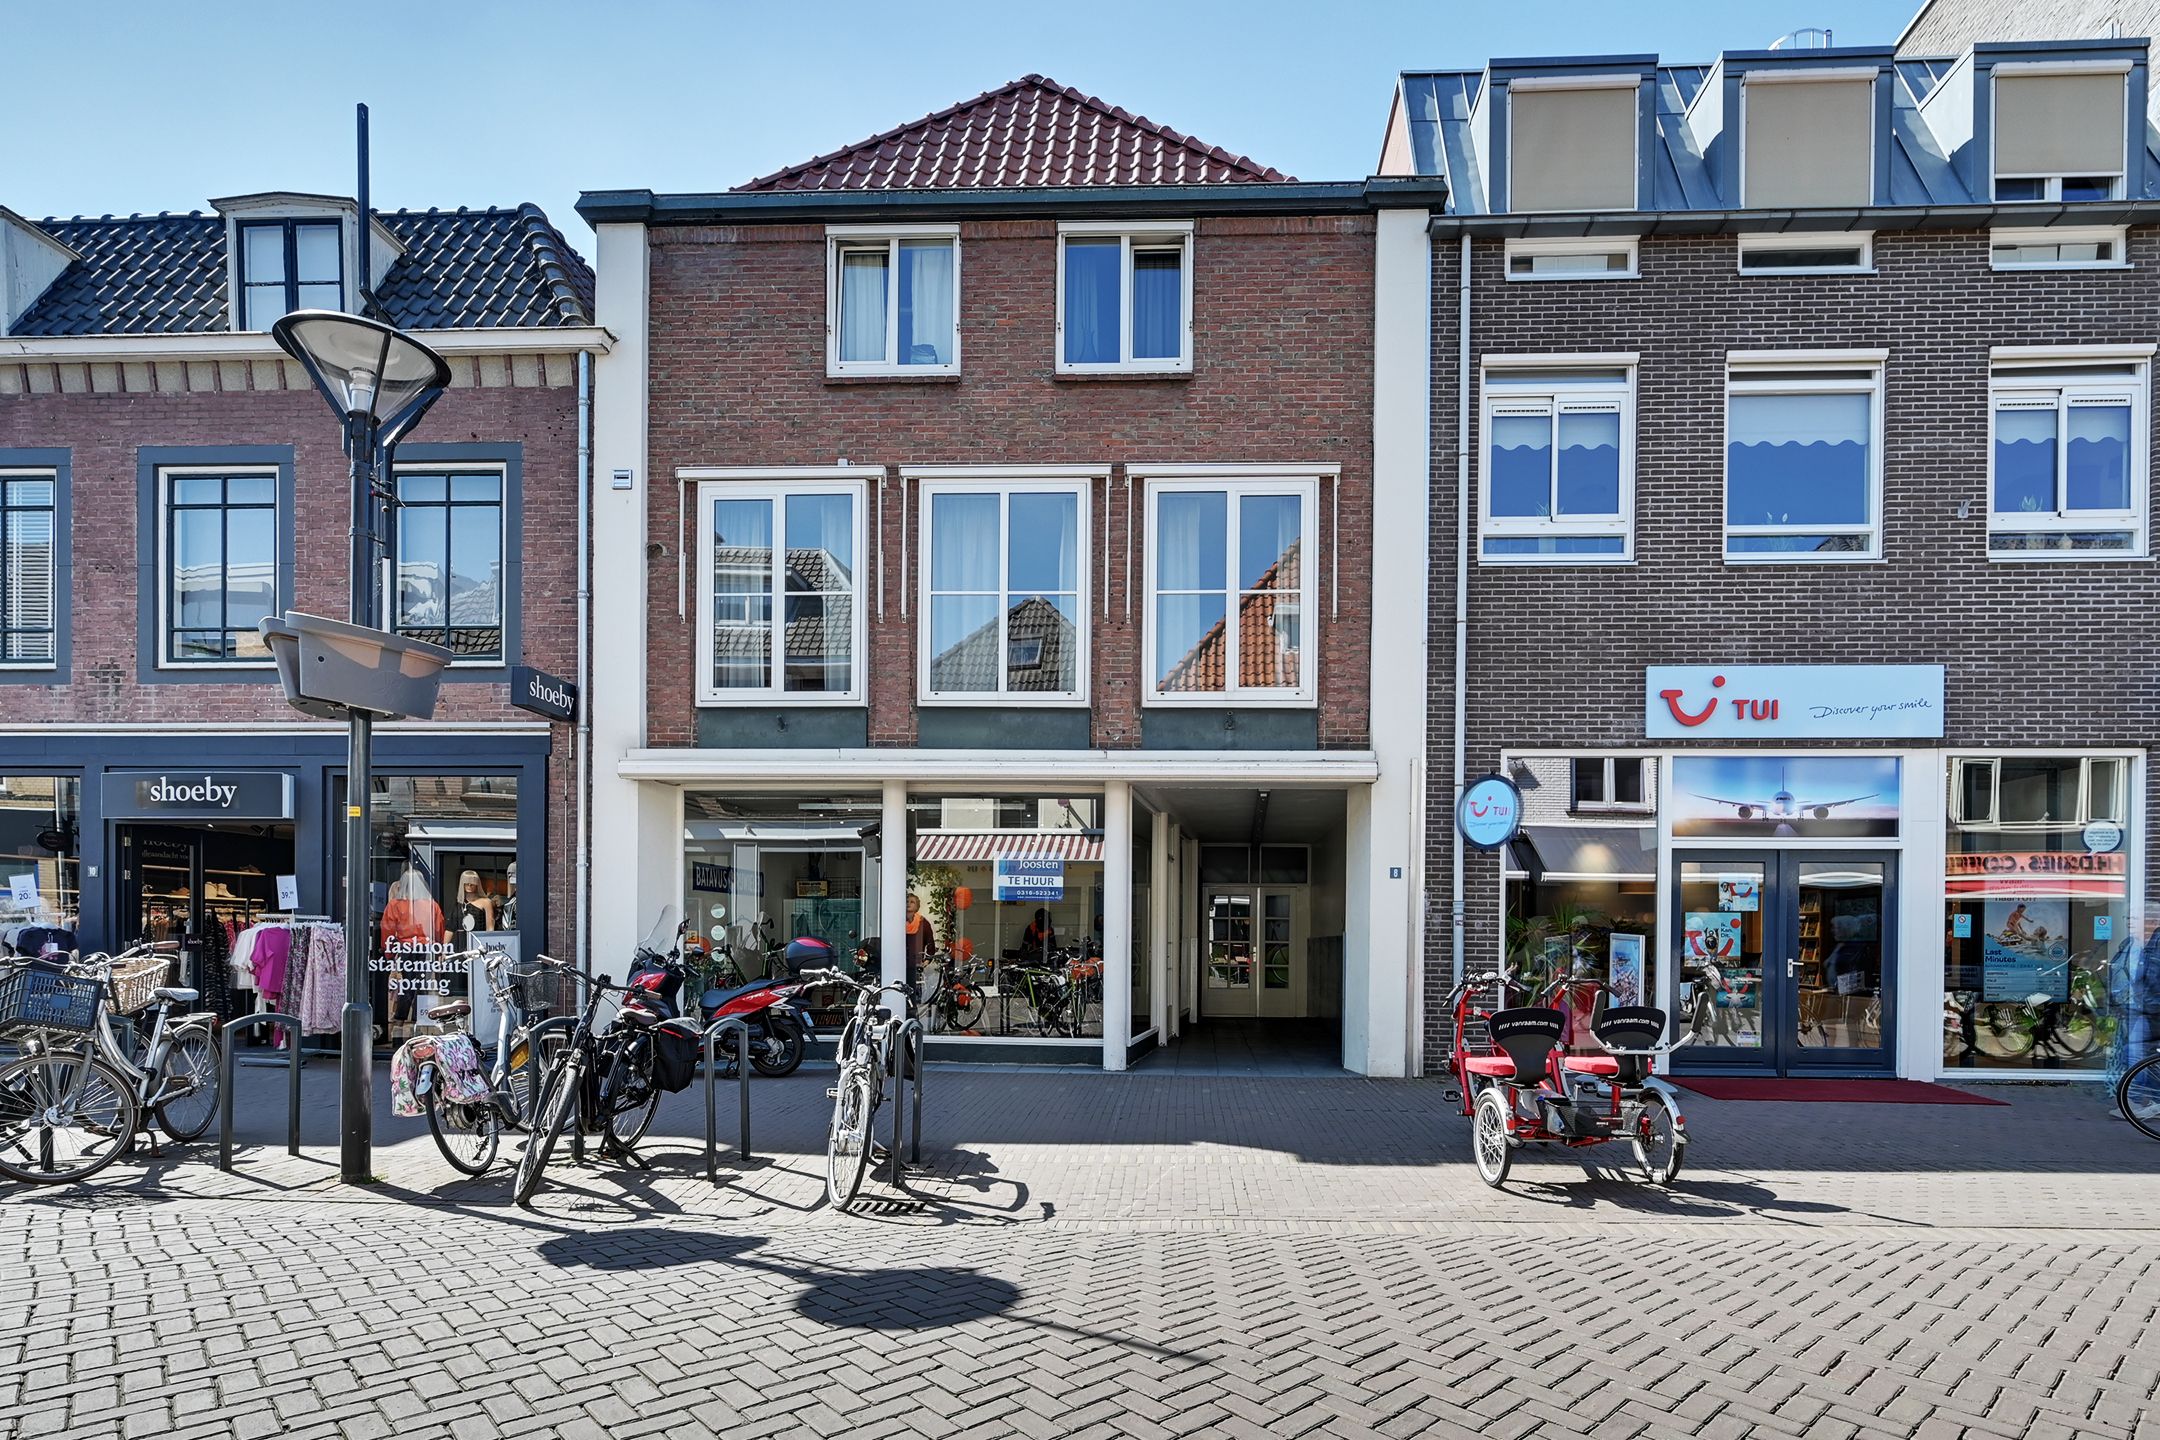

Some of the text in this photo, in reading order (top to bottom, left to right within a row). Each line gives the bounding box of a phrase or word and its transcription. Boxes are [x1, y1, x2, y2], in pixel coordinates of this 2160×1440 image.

[529, 675, 574, 715] shoeby
[1732, 699, 1779, 720] TUI
[1809, 697, 1933, 721] Discover your smile
[150, 775, 238, 808] shoeby
[1493, 806, 1509, 816] TUI
[89, 867, 96, 876] 10
[1019, 860, 1058, 870] Joosten
[1393, 868, 1399, 878] 8
[696, 866, 728, 889] BATAVUS
[1008, 876, 1055, 886] TE HUUR
[384, 935, 455, 954] fashion
[368, 957, 470, 974] statements
[388, 973, 451, 996] spring
